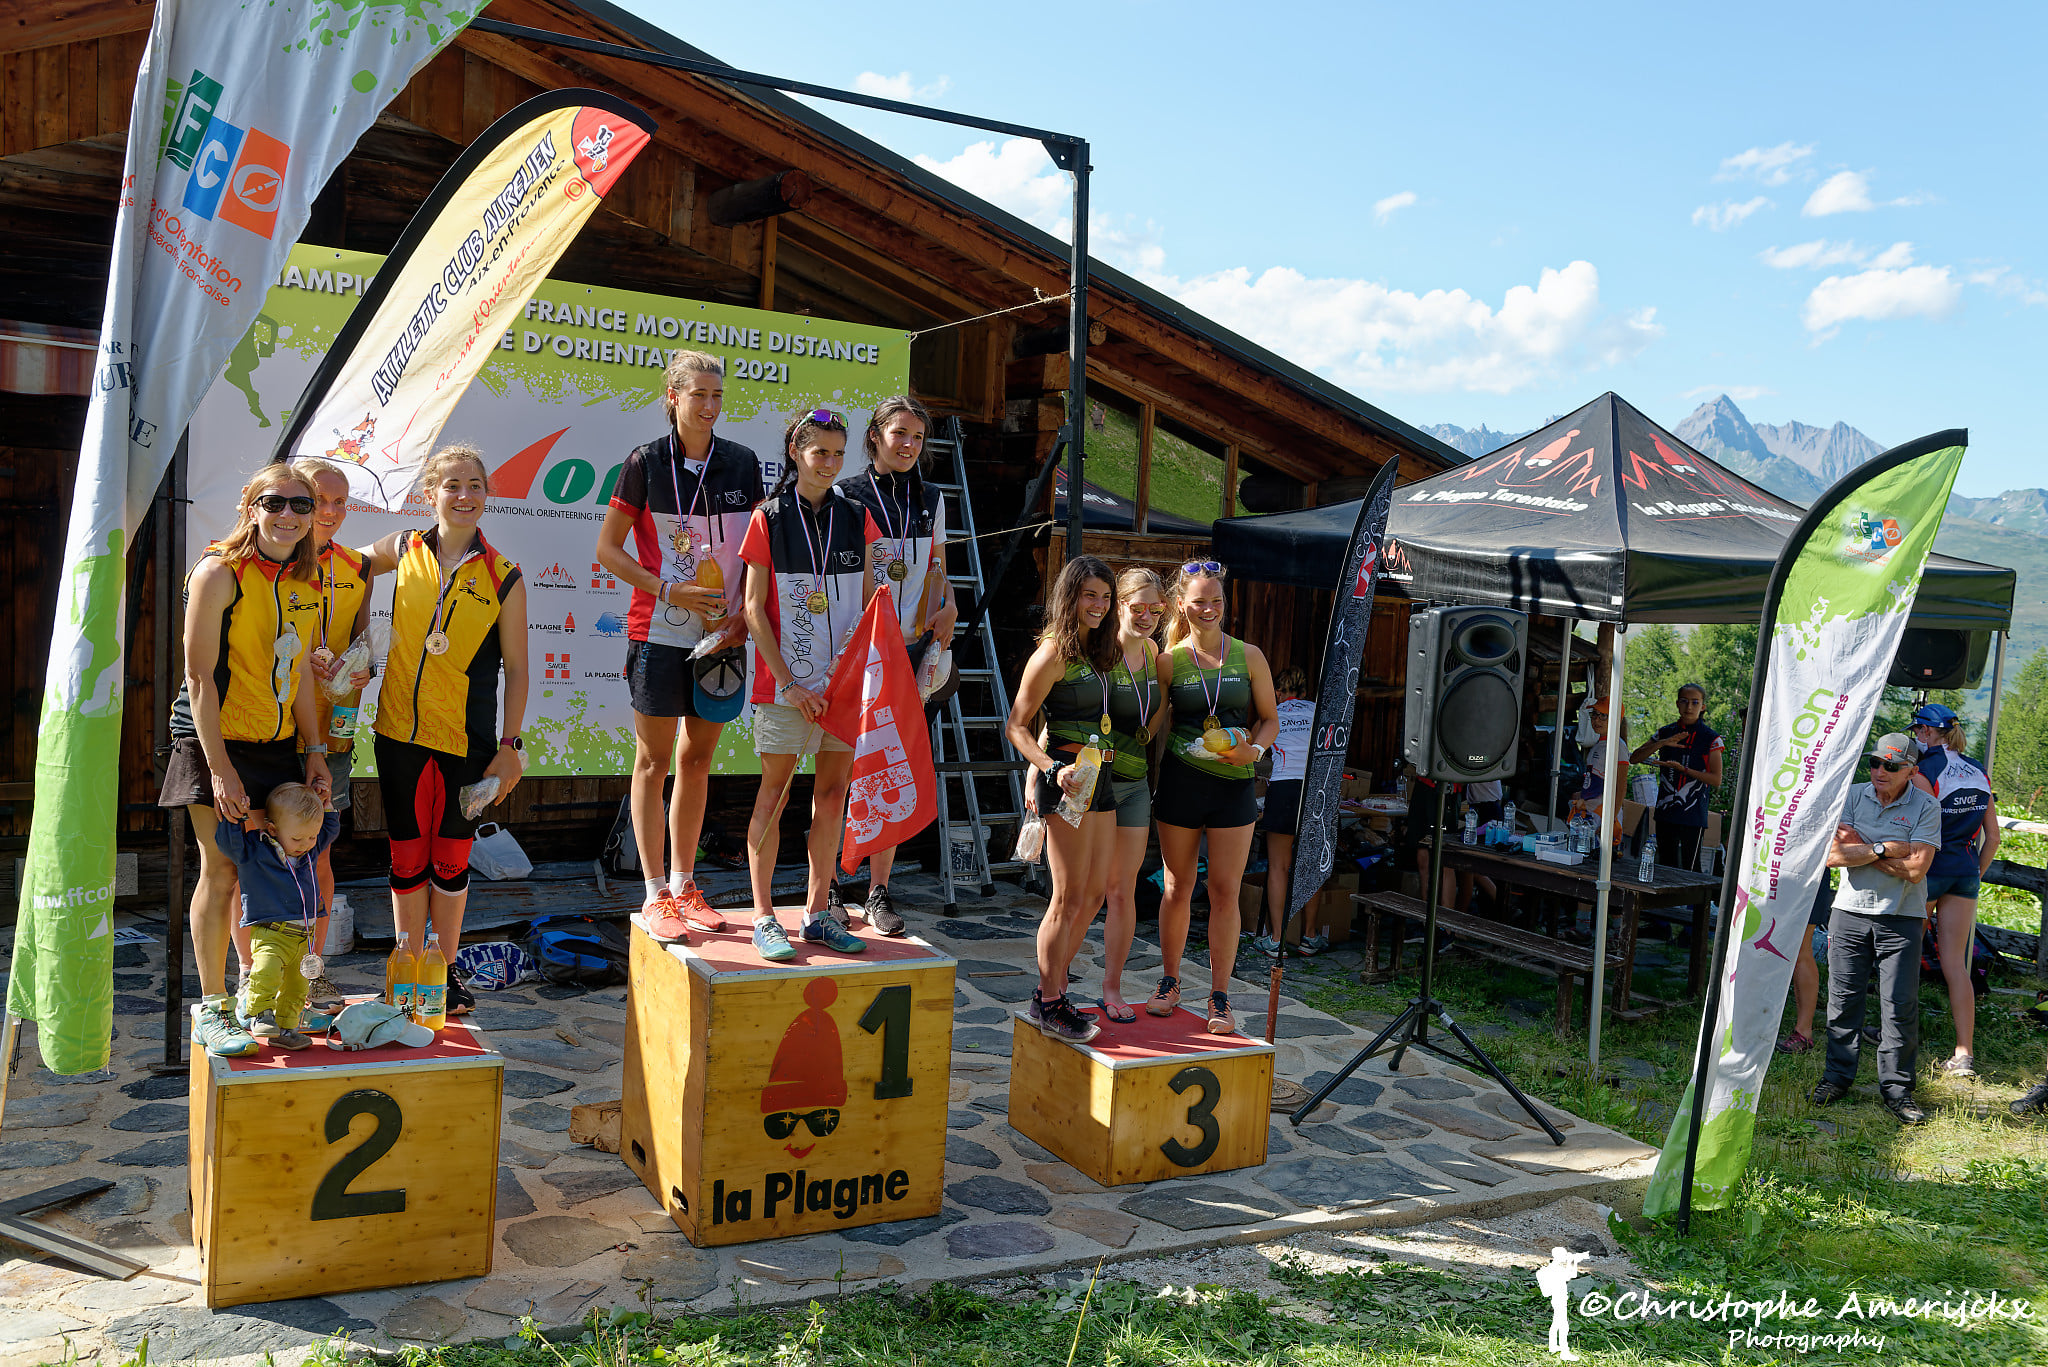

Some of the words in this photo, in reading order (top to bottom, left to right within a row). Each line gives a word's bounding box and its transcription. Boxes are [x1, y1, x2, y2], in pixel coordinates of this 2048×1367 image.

[466, 159, 565, 296] Aix-en-Provence
[372, 283, 447, 407] ATHLETIC
[443, 229, 484, 295] CLUB
[525, 299, 626, 331] FRANCE
[635, 313, 760, 348] MOYENNE
[769, 331, 878, 364] DISTANCE
[734, 358, 788, 383] 2021
[346, 504, 385, 514] dération
[484, 505, 534, 516] ERNATIONAL
[536, 509, 592, 520] ORIENTEERING
[1427, 490, 1488, 503] Plagne
[1489, 489, 1588, 512] Tarentaise
[1632, 502, 1663, 516] la
[1656, 501, 1725, 517] Plagne
[595, 671, 620, 679] PLAGNE
[857, 984, 913, 1100] 1
[1160, 1067, 1221, 1168] 3
[311, 1089, 406, 1221] 2
[713, 1179, 751, 1225] la
[764, 1169, 910, 1220] Plagne
